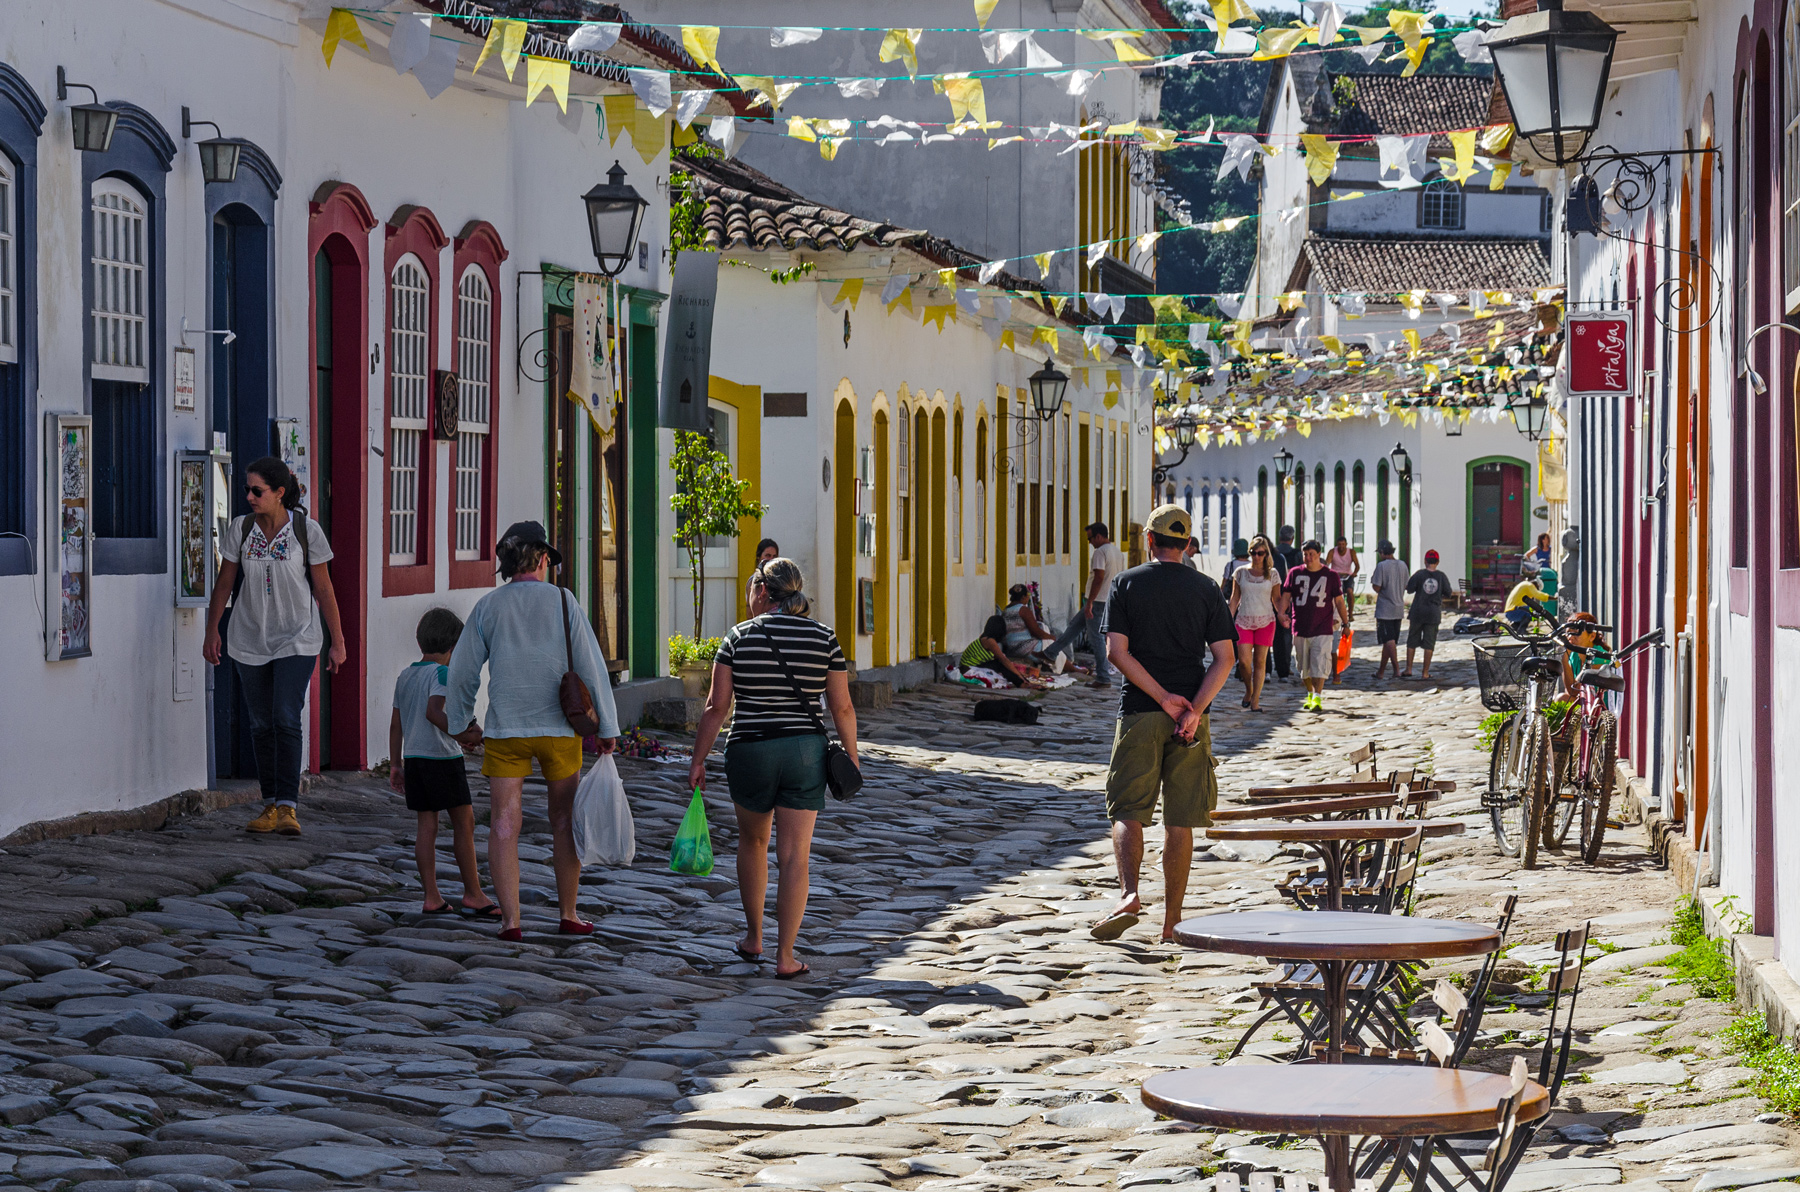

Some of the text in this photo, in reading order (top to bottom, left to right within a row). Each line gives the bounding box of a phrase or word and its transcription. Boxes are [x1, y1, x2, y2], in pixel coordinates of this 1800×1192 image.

[678, 294, 710, 307] RICHARDS
[1602, 323, 1625, 389] pitanga
[1295, 575, 1327, 607] 34
